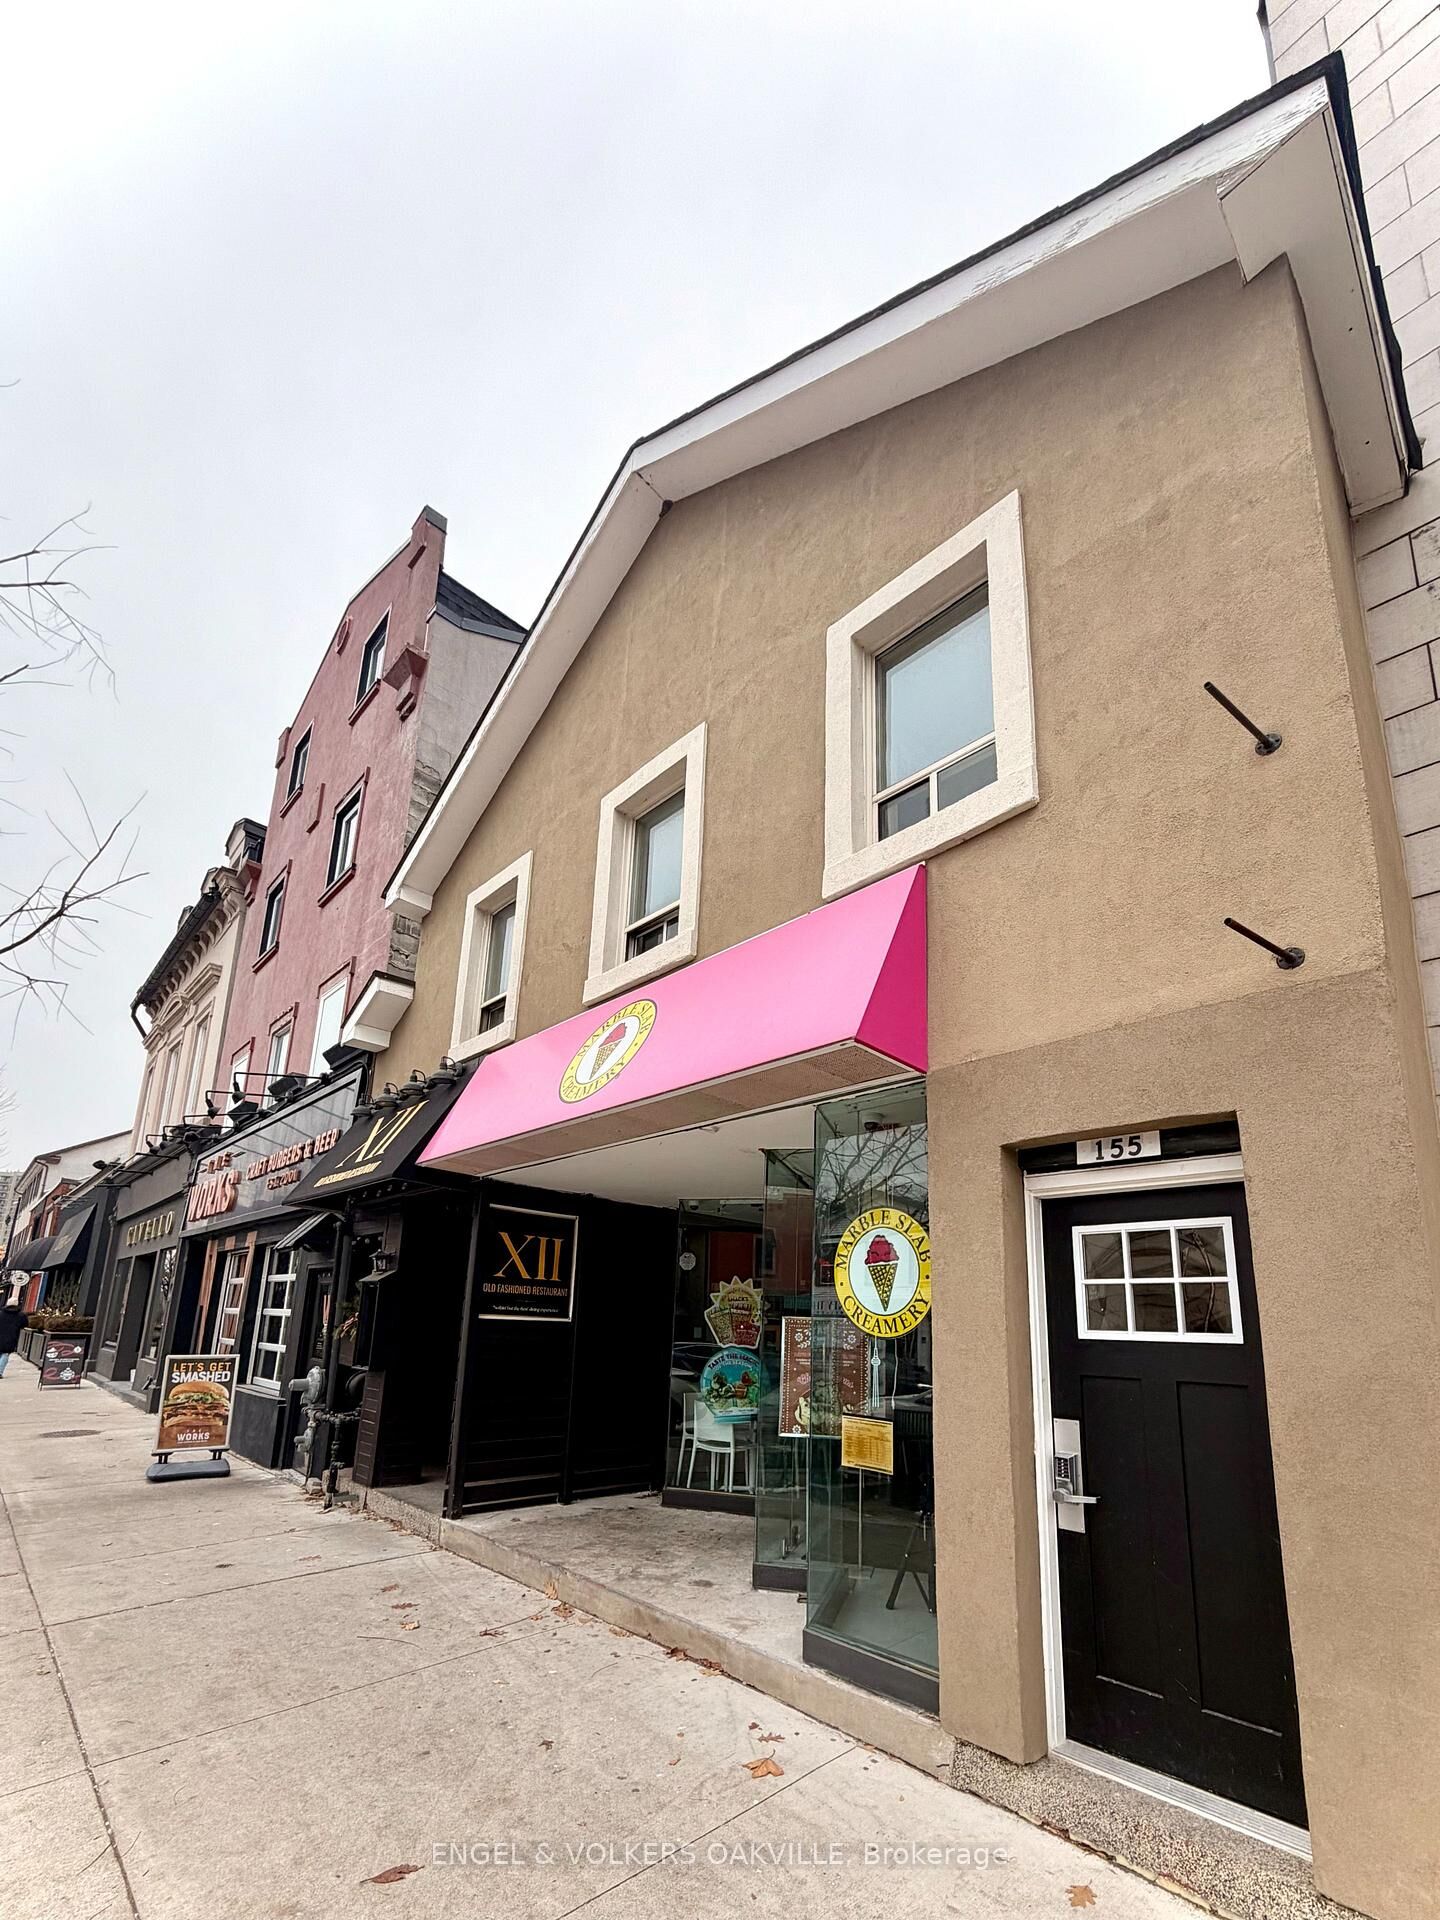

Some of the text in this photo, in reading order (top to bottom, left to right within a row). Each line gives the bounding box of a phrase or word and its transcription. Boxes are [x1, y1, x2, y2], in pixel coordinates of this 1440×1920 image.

[577, 1003, 640, 1056] MARBLE
[562, 1056, 624, 1099] CREAMERY
[246, 1127, 341, 1181] CRAFT BURGERS & BEER
[335, 1099, 430, 1169] XII
[1095, 1134, 1142, 1160] 155
[187, 1169, 241, 1222] WORKS
[126, 1211, 175, 1247] CIVELLO
[836, 1209, 891, 1271] MARBLE
[493, 1231, 565, 1281] XII
[483, 1282, 568, 1297] OLD FASHIONED RESTAURANT
[843, 1290, 930, 1335] CREAMERY
[171, 1371, 231, 1383] SMASHED
[173, 1362, 231, 1372] LET'S GET
[177, 1432, 210, 1441] WORKS
